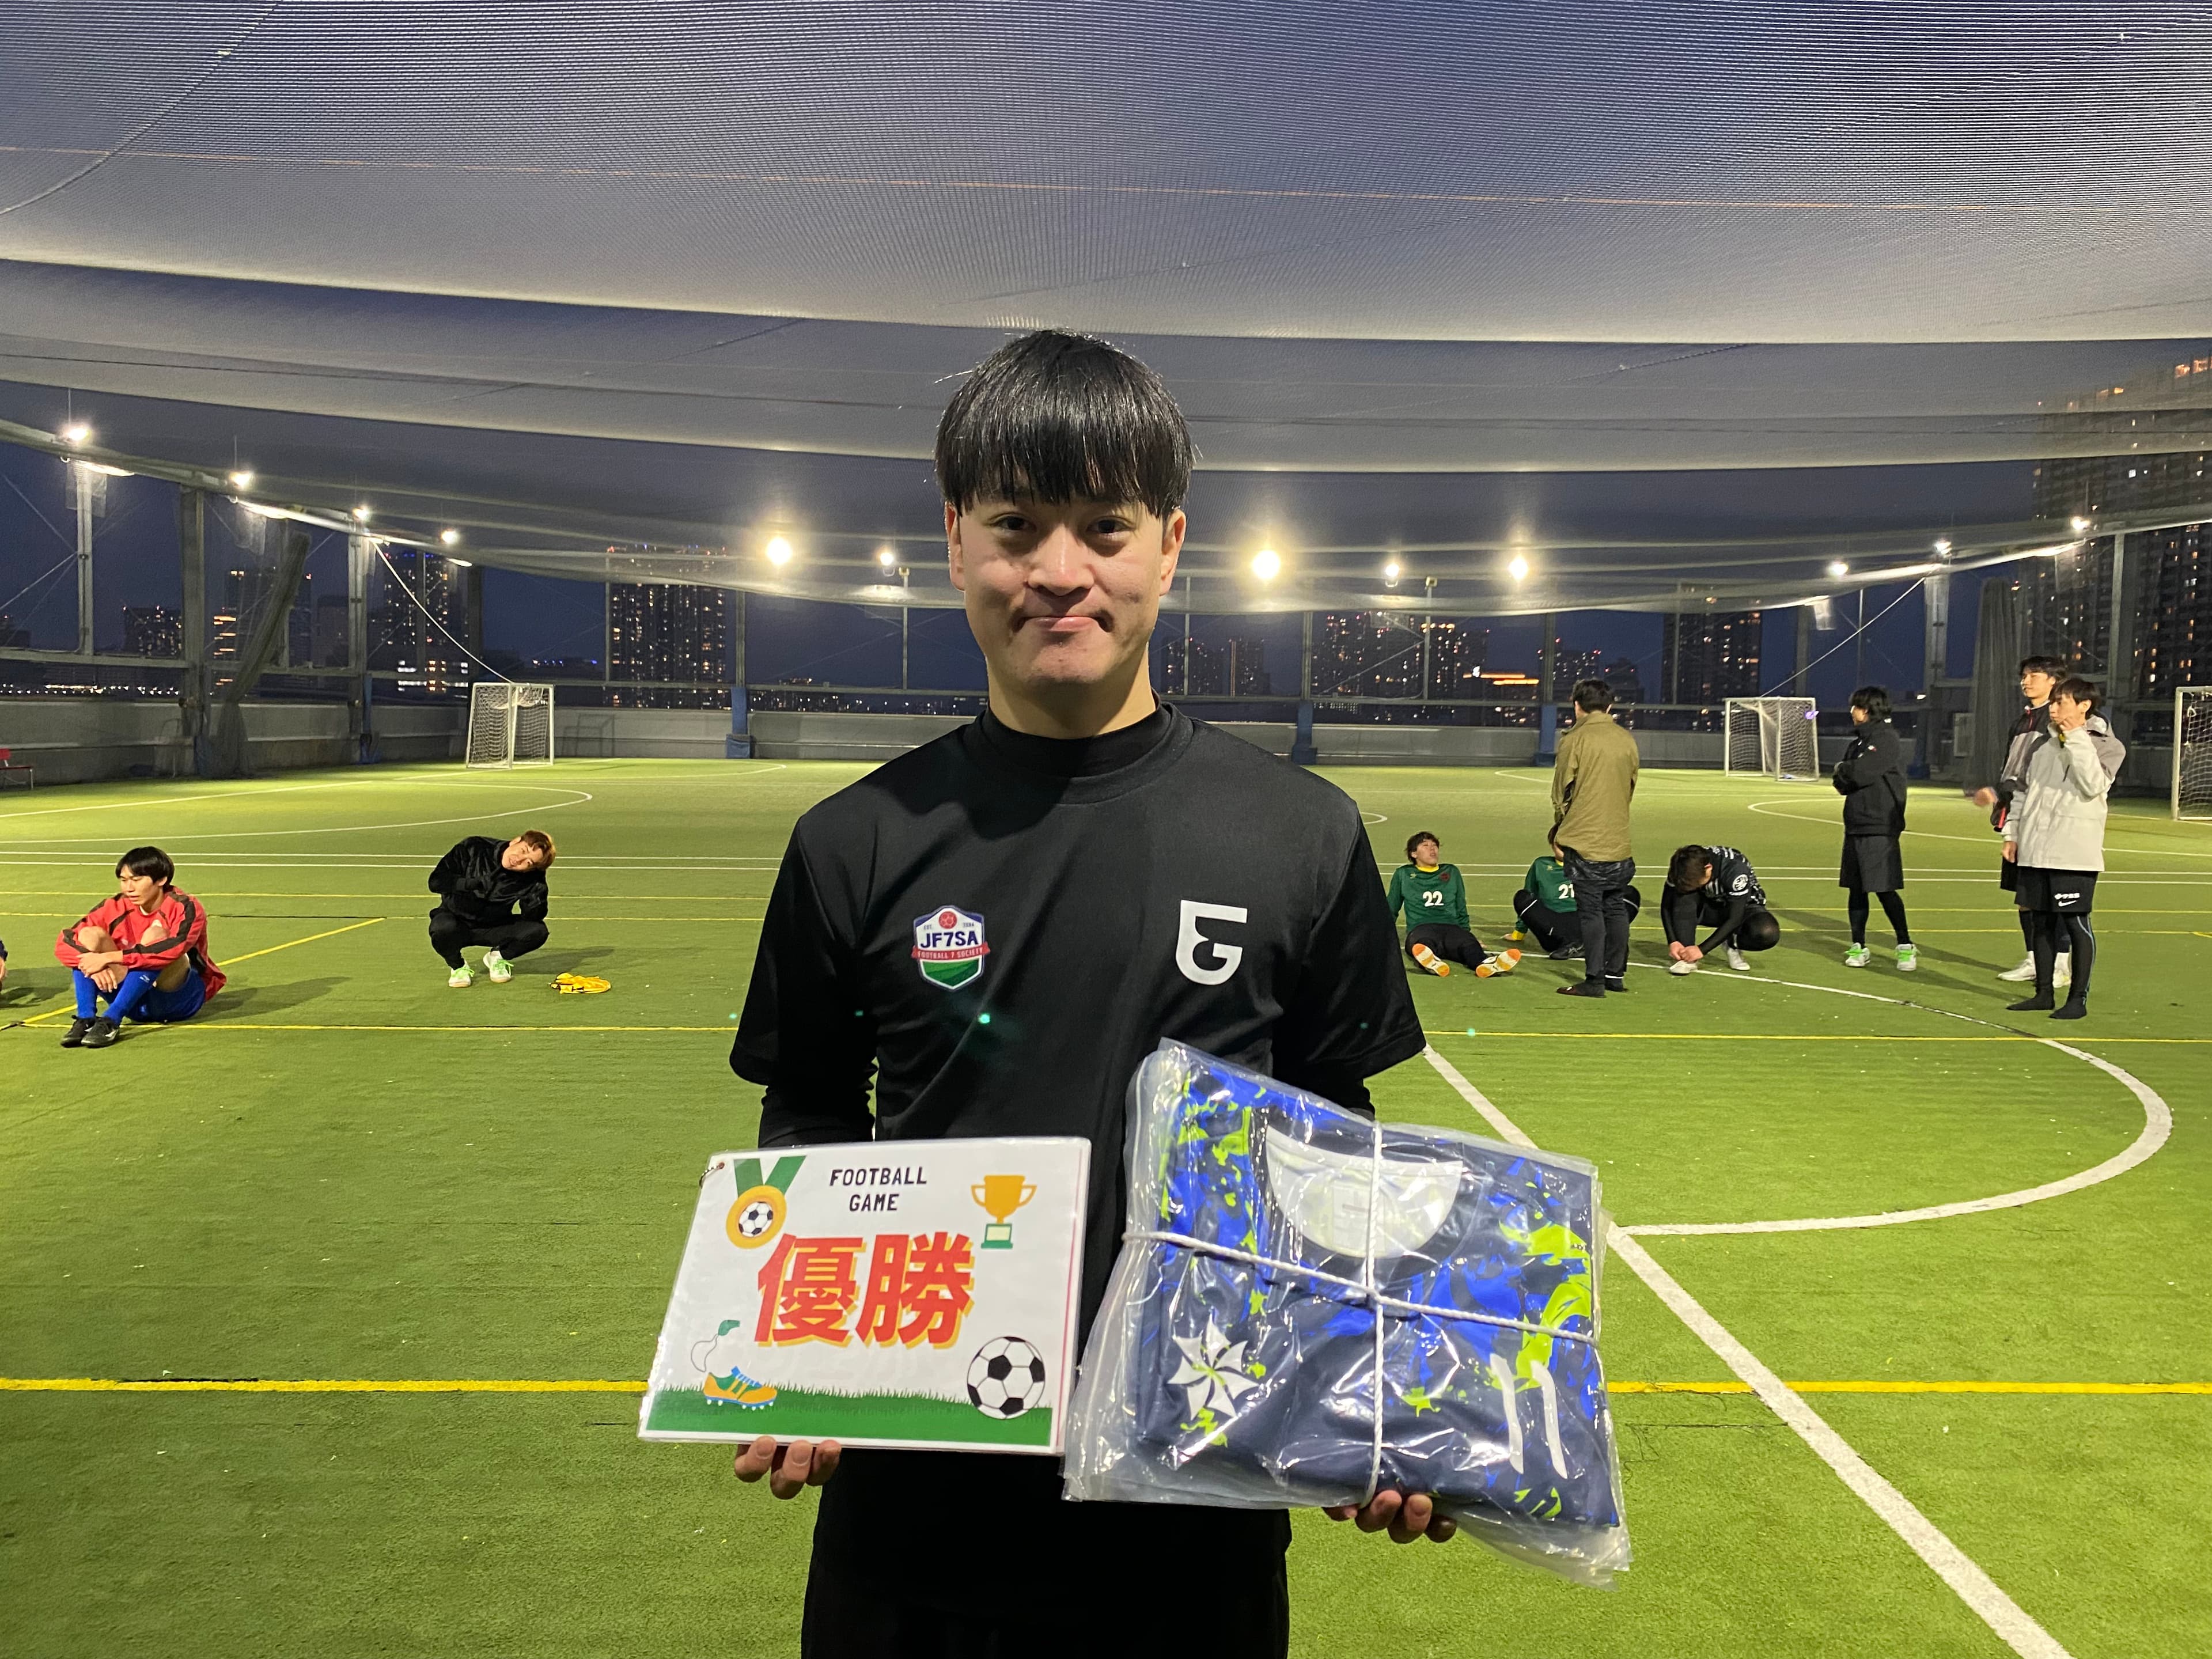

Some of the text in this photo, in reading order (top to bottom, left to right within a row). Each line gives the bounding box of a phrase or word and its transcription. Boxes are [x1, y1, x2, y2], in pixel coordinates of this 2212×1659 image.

[1423, 891, 1444, 907] 22
[1558, 884, 1575, 899] 21
[921, 931, 979, 948] JF7SA
[918, 950, 949, 959] FOOTBALL
[957, 947, 983, 959] SOCIETY
[830, 1166, 927, 1187] FOOTBALL
[849, 1194, 899, 1212] GAME
[754, 1232, 975, 1349] 優勝
